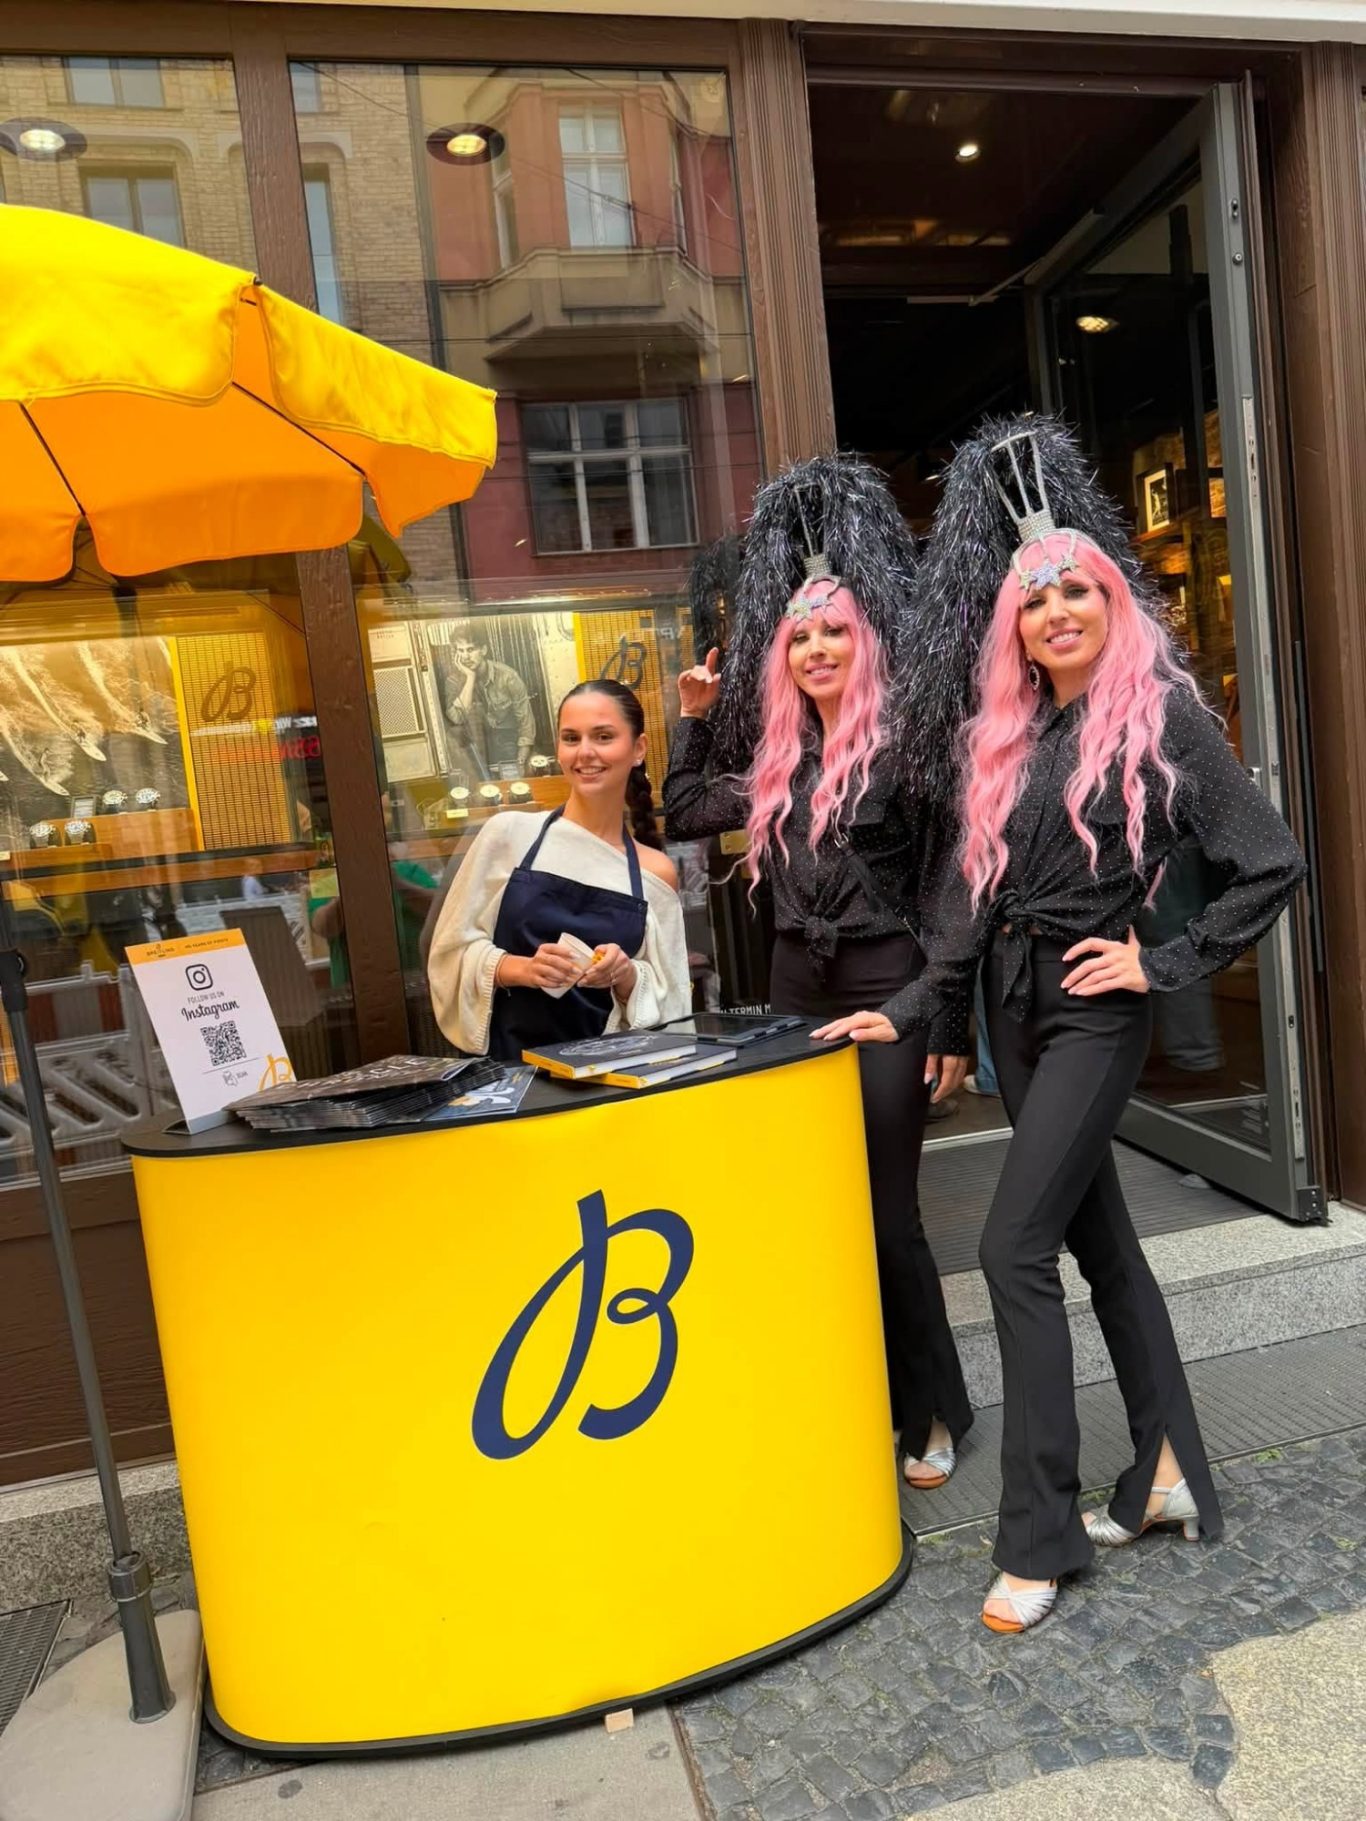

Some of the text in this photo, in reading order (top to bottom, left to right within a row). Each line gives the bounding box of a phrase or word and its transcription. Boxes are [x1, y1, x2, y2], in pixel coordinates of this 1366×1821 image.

[200, 661, 256, 722] B
[181, 1000, 239, 1021] Instagram
[729, 1005, 763, 1016] TERMIN
[472, 1189, 695, 1460] B
